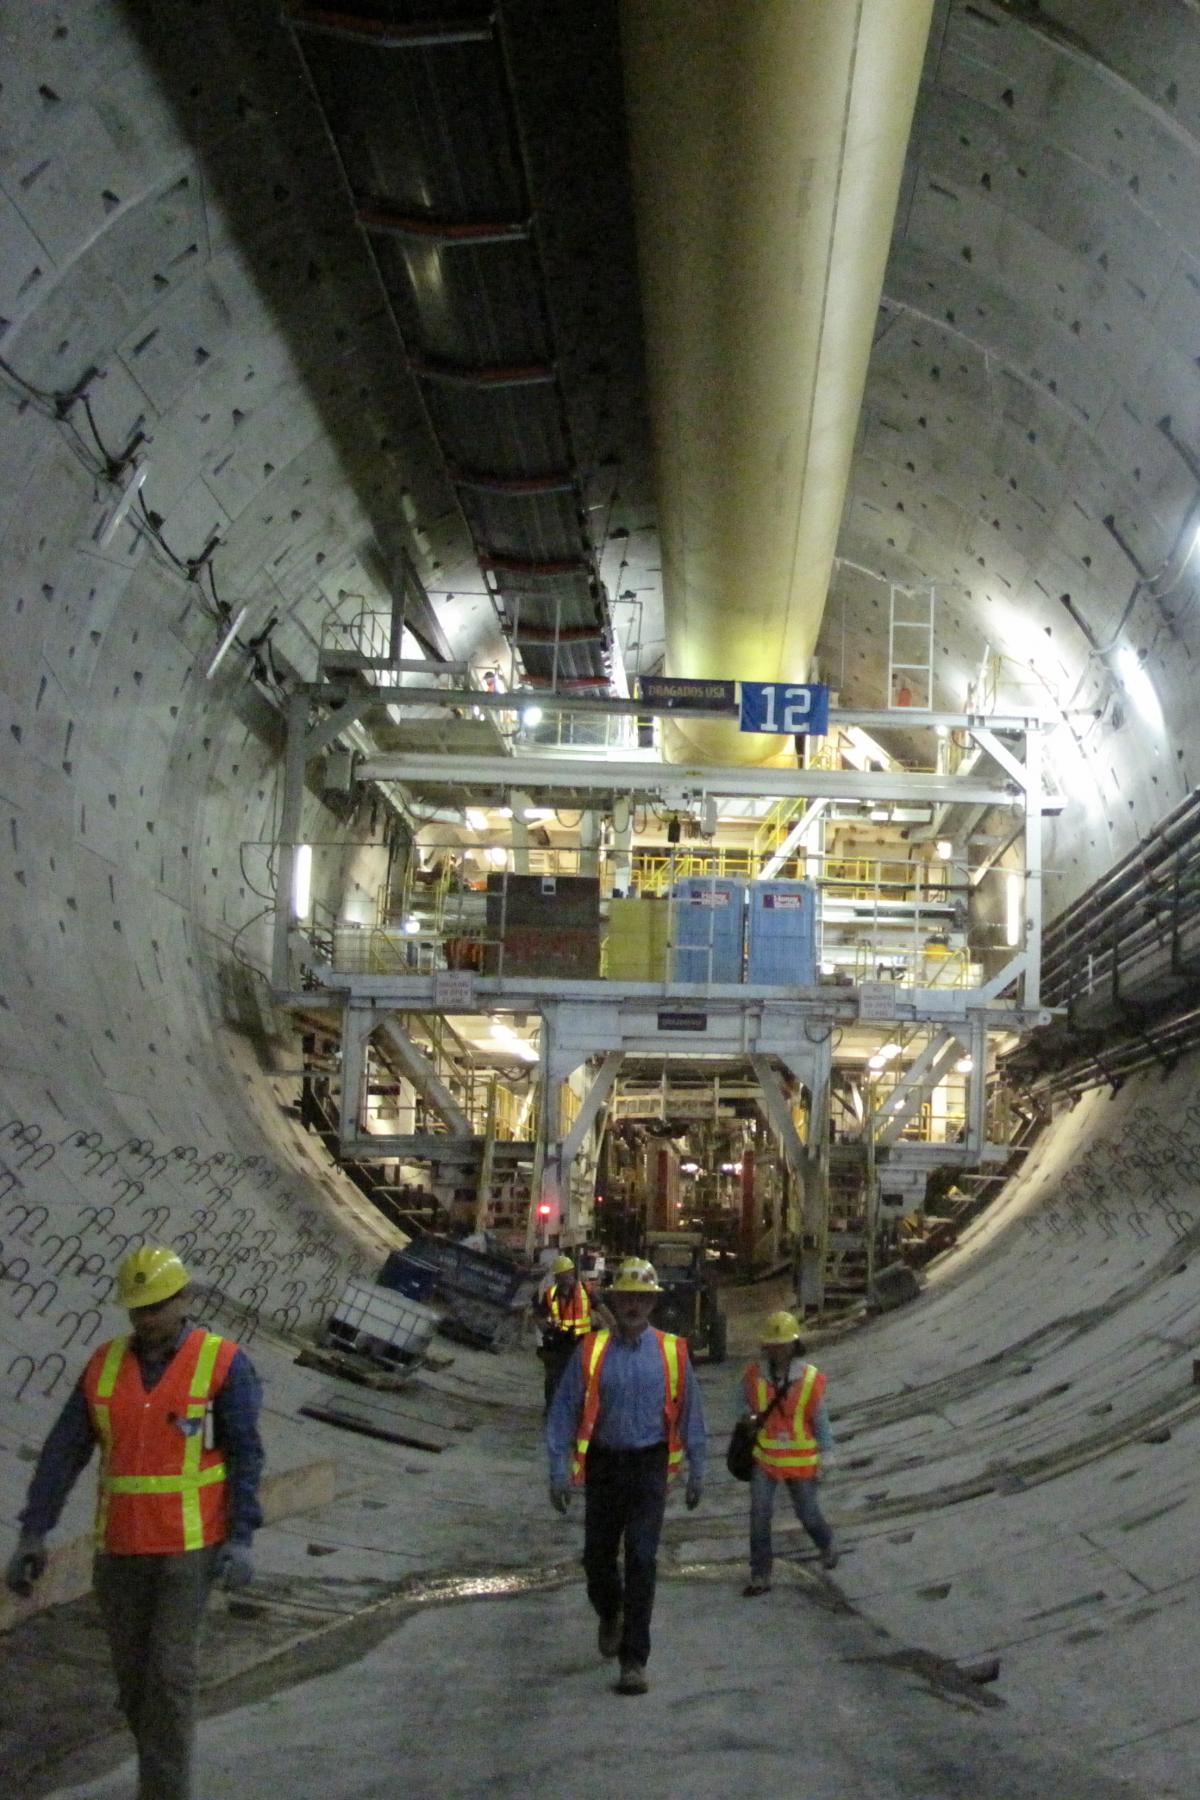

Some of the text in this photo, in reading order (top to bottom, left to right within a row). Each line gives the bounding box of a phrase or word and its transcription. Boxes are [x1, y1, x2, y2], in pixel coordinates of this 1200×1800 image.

[648, 685, 725, 698] DRAGADOS USA
[760, 686, 811, 732] 12
